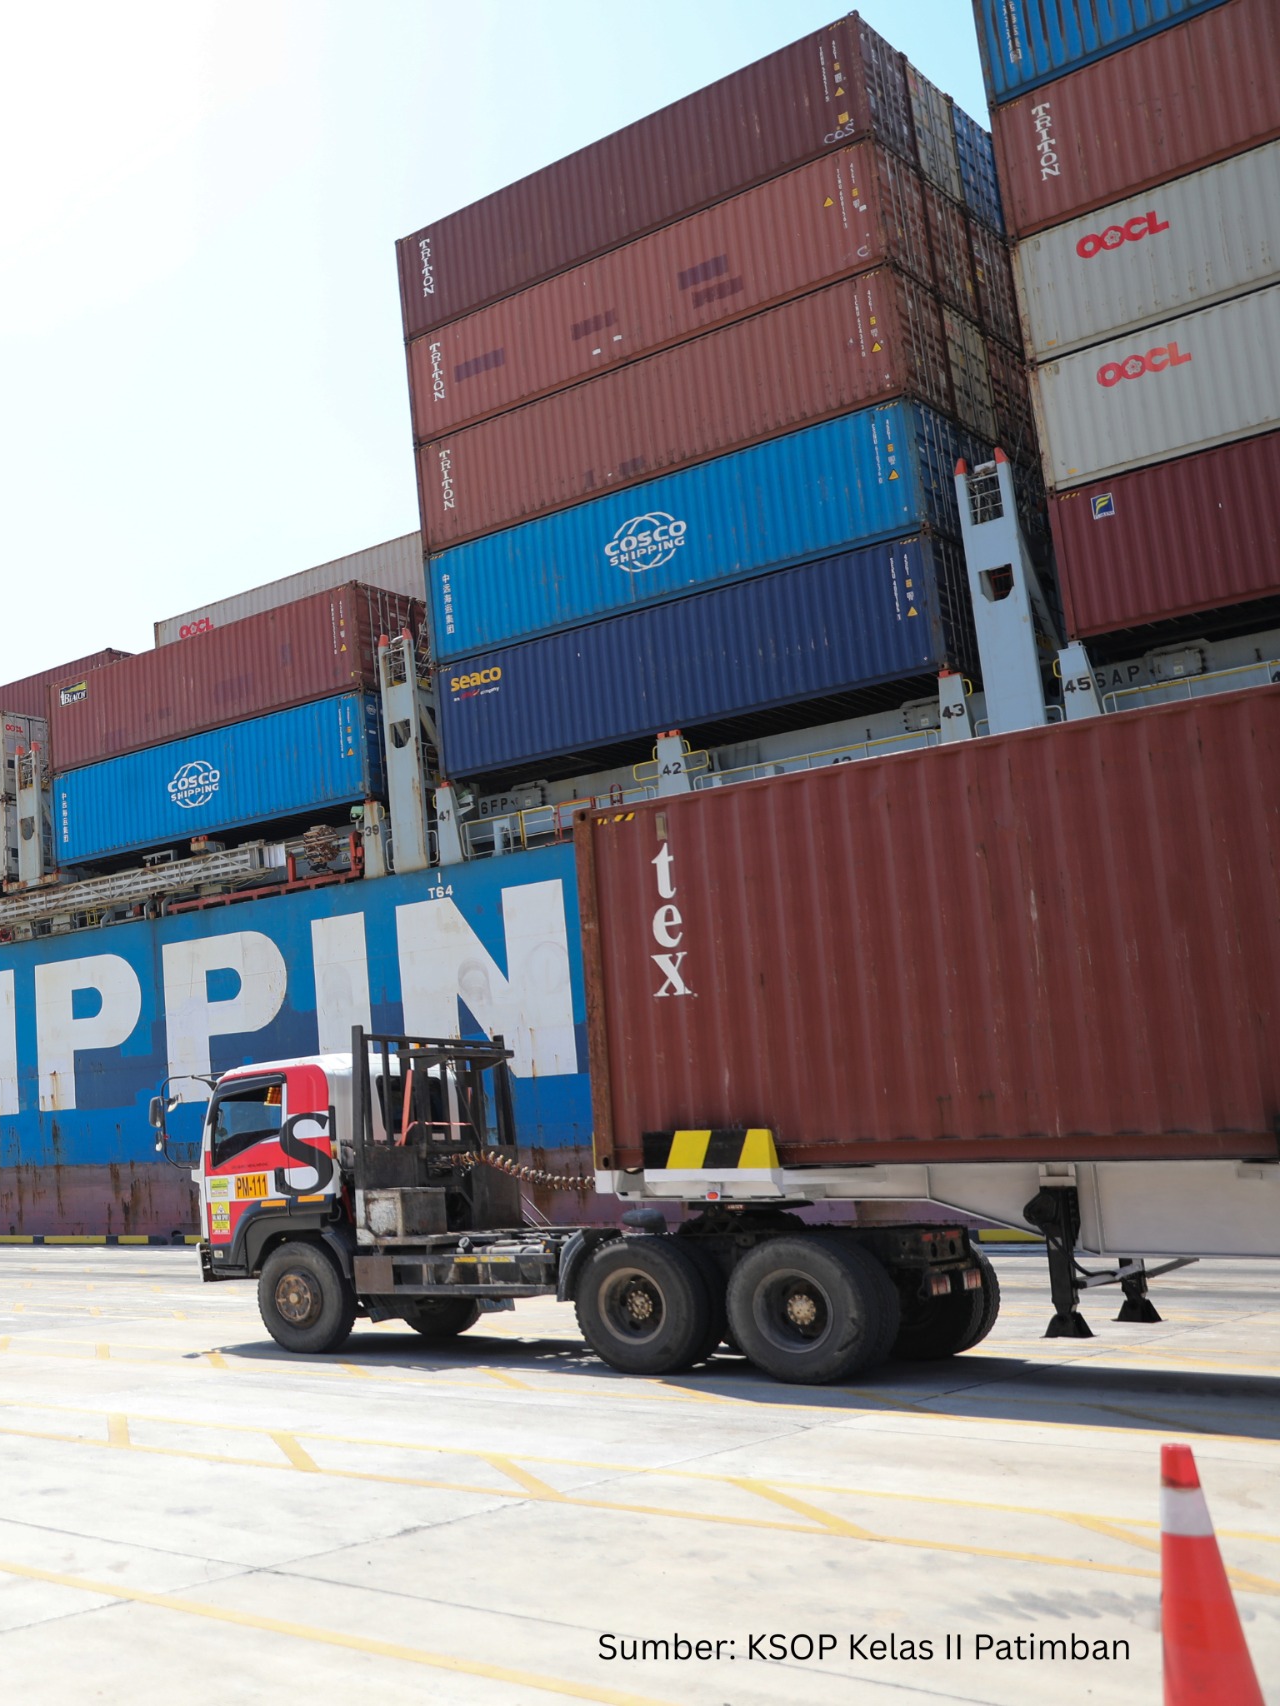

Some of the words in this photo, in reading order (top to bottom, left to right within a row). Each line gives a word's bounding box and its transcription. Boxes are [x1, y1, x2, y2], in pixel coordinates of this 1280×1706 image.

[1031, 101, 1061, 181] TRITON
[1076, 210, 1170, 259] OOCL
[419, 238, 435, 298] TRITON
[429, 342, 446, 402] TRITON
[1096, 342, 1192, 388] OOCL
[439, 449, 456, 511] TRITON
[604, 520, 687, 556] COSCO
[610, 536, 686, 567] SHIPPING
[178, 616, 214, 639] OOCL
[451, 666, 502, 692] seaco
[1065, 676, 1091, 693] 45
[941, 702, 966, 719] 43
[6, 723, 23, 733] OOCL
[661, 760, 683, 776] 42
[167, 769, 221, 793] COSCO
[170, 783, 219, 802] SHIPPING
[438, 810, 451, 822] 41
[364, 824, 380, 838] 39
[428, 884, 455, 899] T64
[650, 842, 694, 998] tex
[280, 1112, 334, 1197] S
[236, 1175, 268, 1198] PM-111
